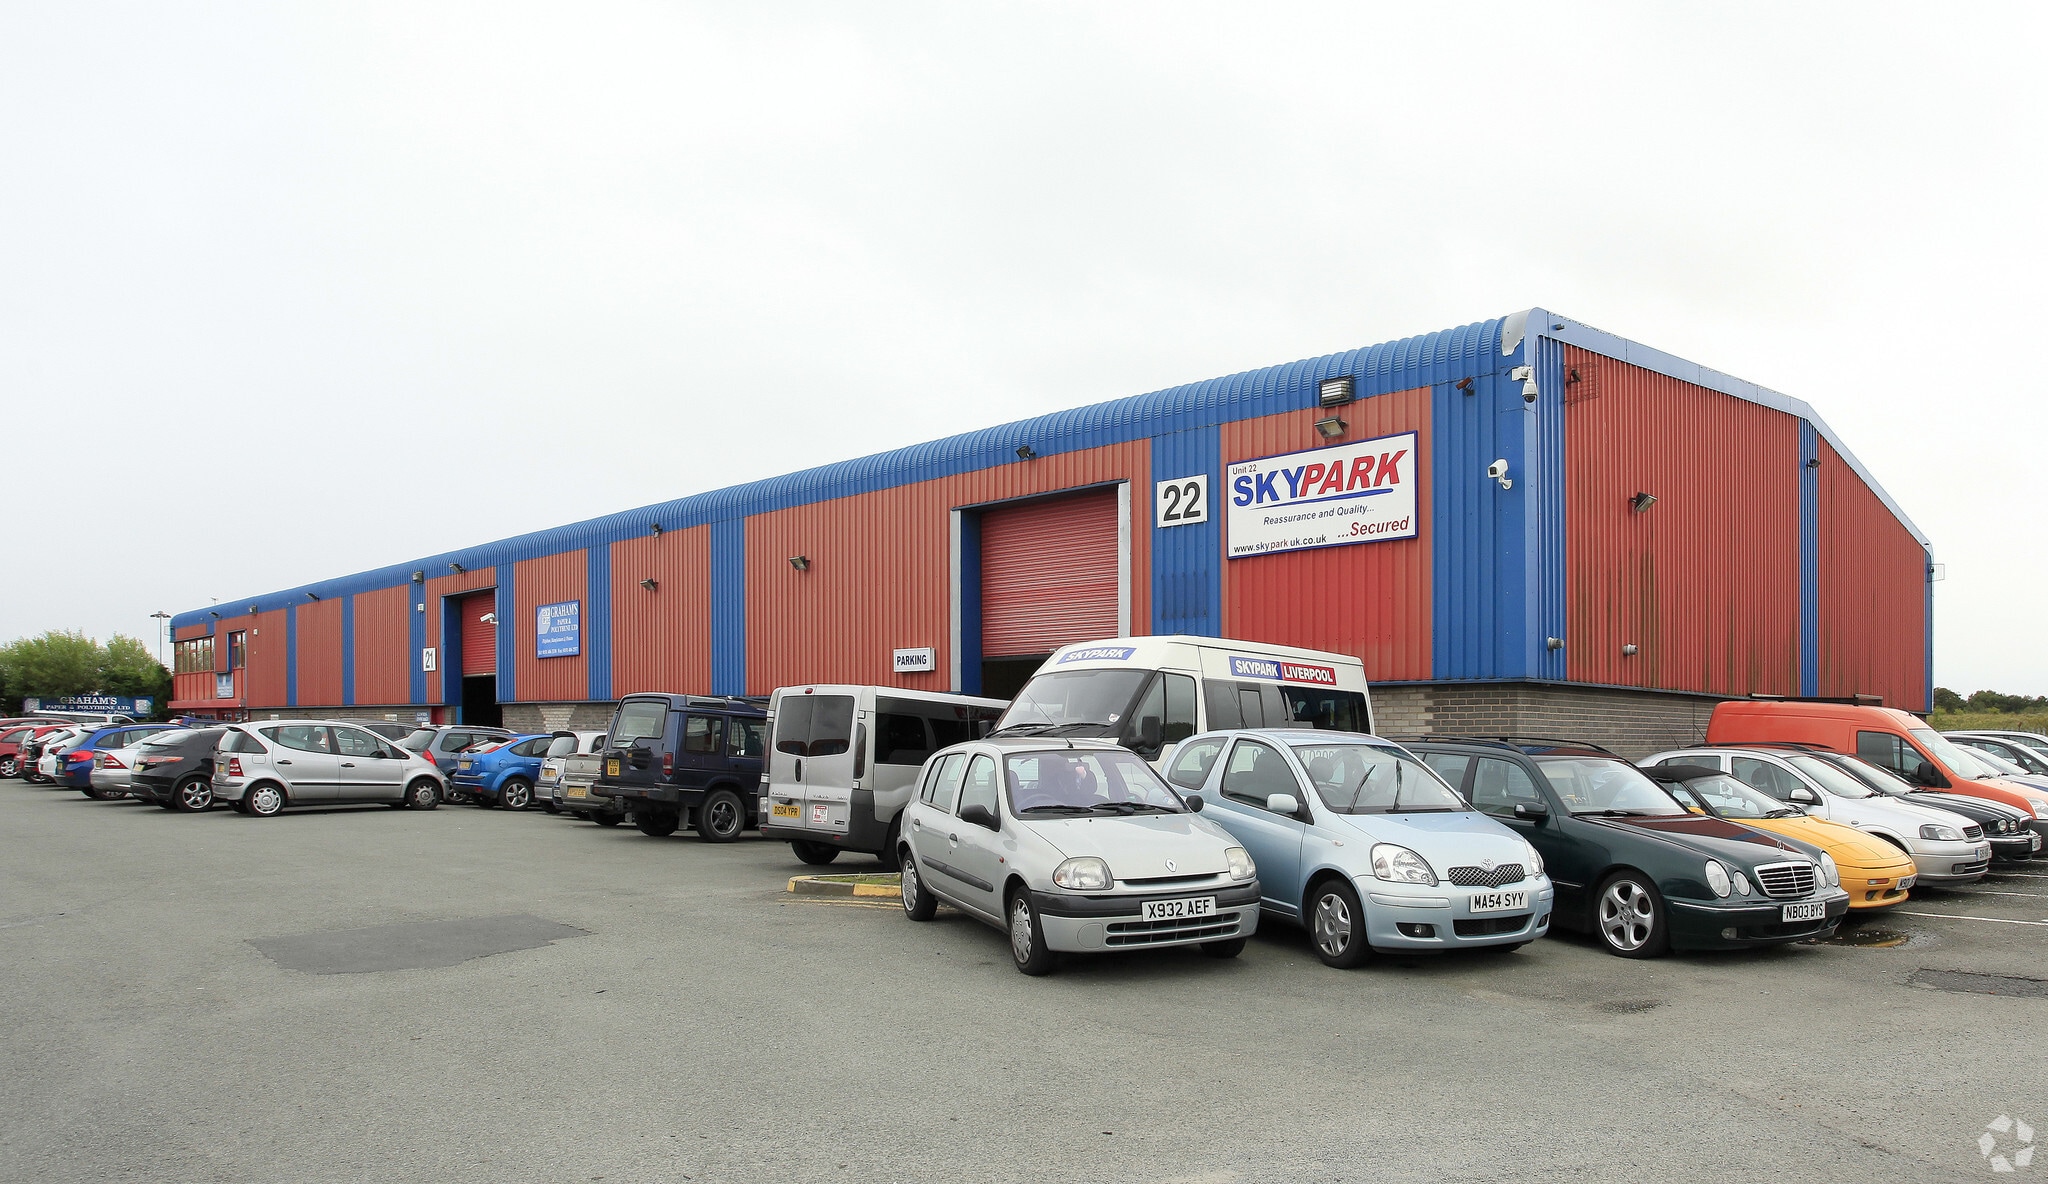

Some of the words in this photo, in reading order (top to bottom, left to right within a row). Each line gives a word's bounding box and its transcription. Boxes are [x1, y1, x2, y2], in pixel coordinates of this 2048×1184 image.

[1232, 466, 1247, 475] Unit
[1248, 463, 1257, 473] 22
[1233, 449, 1408, 507] SKYPARK
[1163, 481, 1201, 521] 22
[1263, 511, 1317, 525] Reassurance
[1318, 507, 1335, 518] and
[1337, 515, 1410, 538] ...Secured
[425, 650, 434, 669] 21
[896, 654, 927, 666] PARKING
[1065, 648, 1129, 662] SKYPARK
[1235, 659, 1279, 677] SKYPARK
[1283, 665, 1334, 683] LIVERPOOL
[59, 696, 118, 705] GRAHAM'S
[774, 805, 788, 815] DS04
[788, 806, 799, 817] YPR
[1148, 901, 1184, 919] X932
[1187, 899, 1211, 915] AEF
[1474, 893, 1502, 909] MA54
[1504, 892, 1524, 907] SYY
[1786, 904, 1809, 919] NB03
[1810, 903, 1823, 918] BYS
